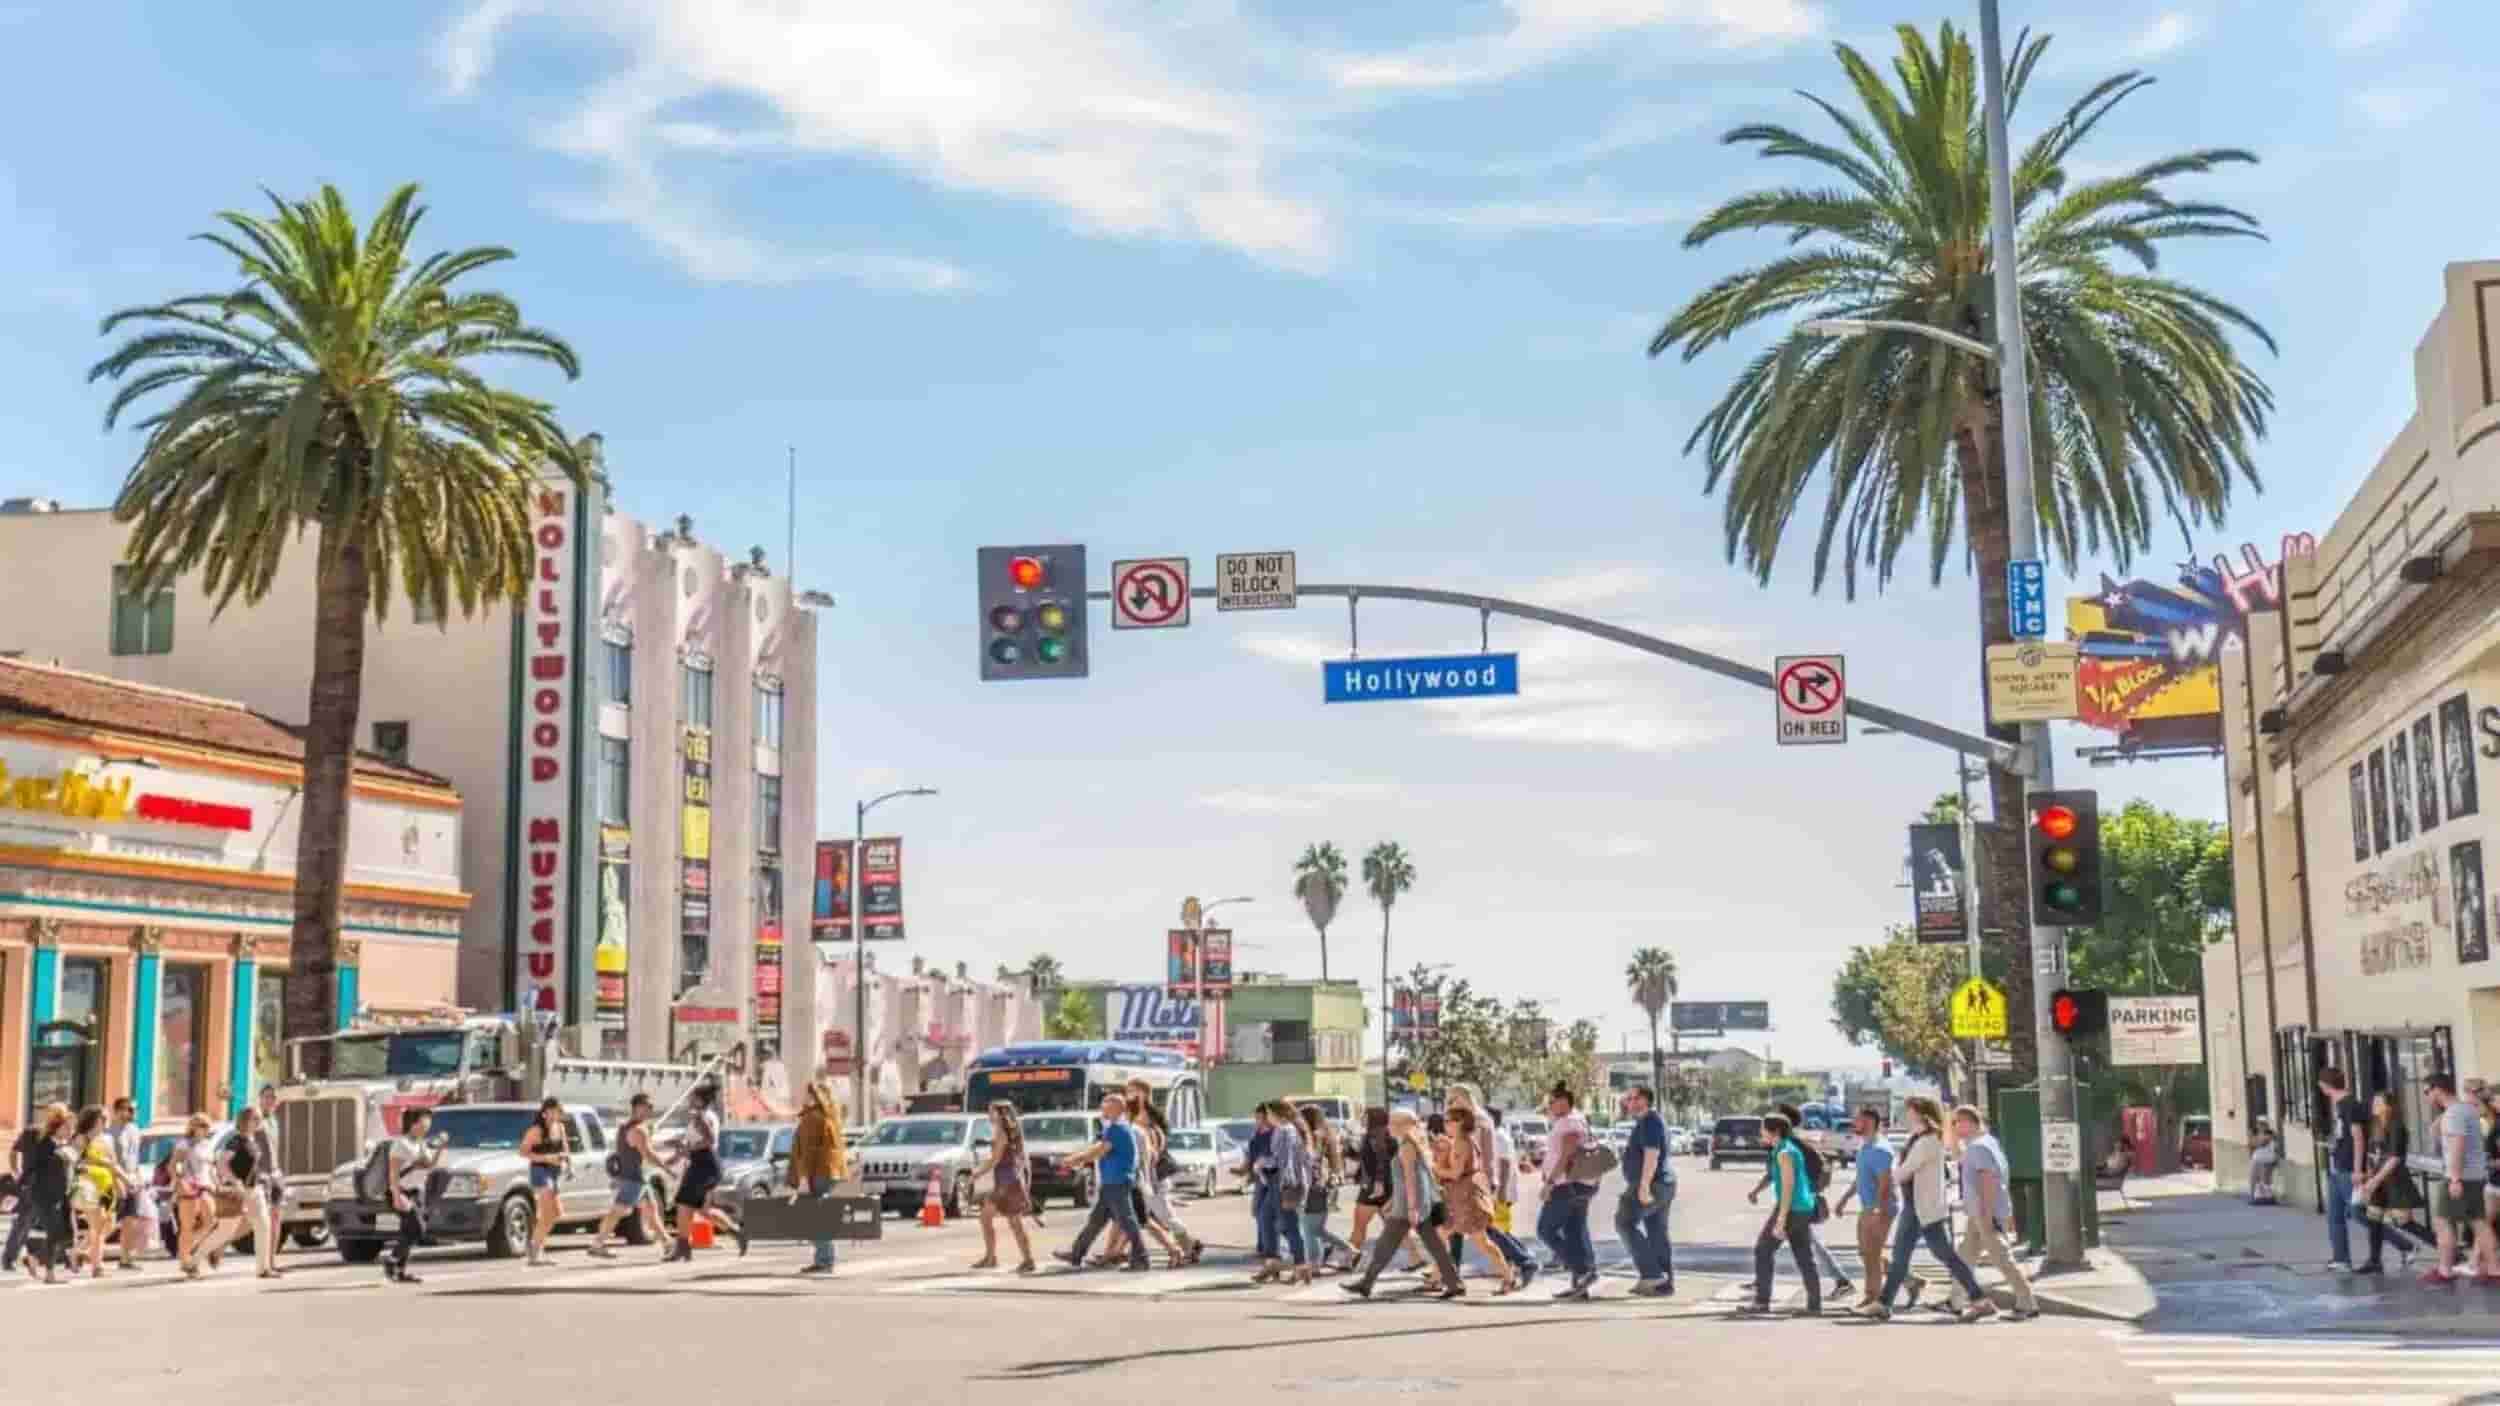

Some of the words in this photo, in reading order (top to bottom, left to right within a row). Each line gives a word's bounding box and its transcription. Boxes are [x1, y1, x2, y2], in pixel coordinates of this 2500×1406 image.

[1226, 559, 1248, 576] DO
[1255, 556, 1284, 573] NOT
[1231, 576, 1281, 593] BLOCK
[2024, 564, 2042, 633] SYNC
[529, 491, 565, 783] HOLLYWOOD
[1344, 663, 1497, 695] Hollywood
[1783, 720, 1805, 736] ON
[1810, 720, 1841, 735] RED
[527, 817, 560, 1011] MUSEUM
[2111, 1007, 2197, 1024] PARKING
